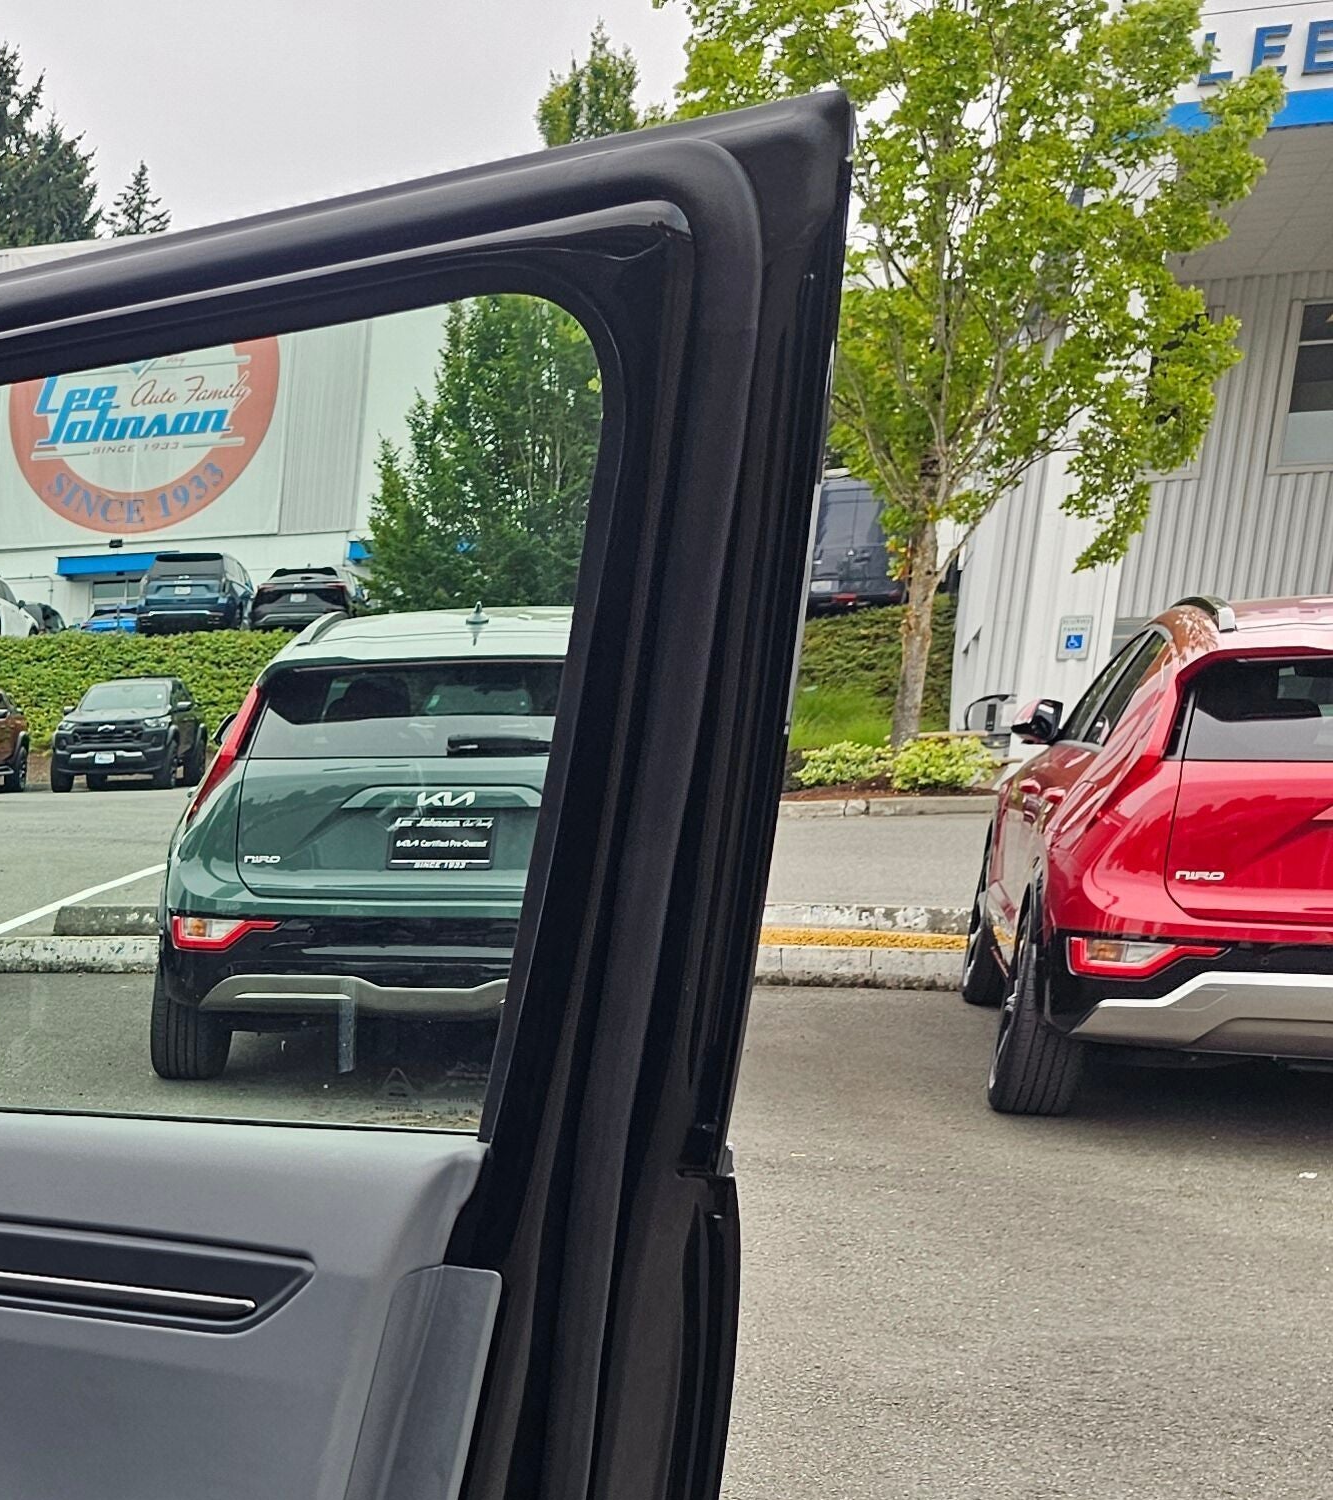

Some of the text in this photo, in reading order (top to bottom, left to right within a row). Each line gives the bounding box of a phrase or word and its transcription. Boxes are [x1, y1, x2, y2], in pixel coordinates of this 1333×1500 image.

[36, 371, 251, 414] Lee Auto Family
[37, 389, 231, 444] Johnson
[92, 442, 180, 455] SINCE 1933
[47, 462, 225, 524] SINCE 1933
[417, 791, 476, 807] KIA
